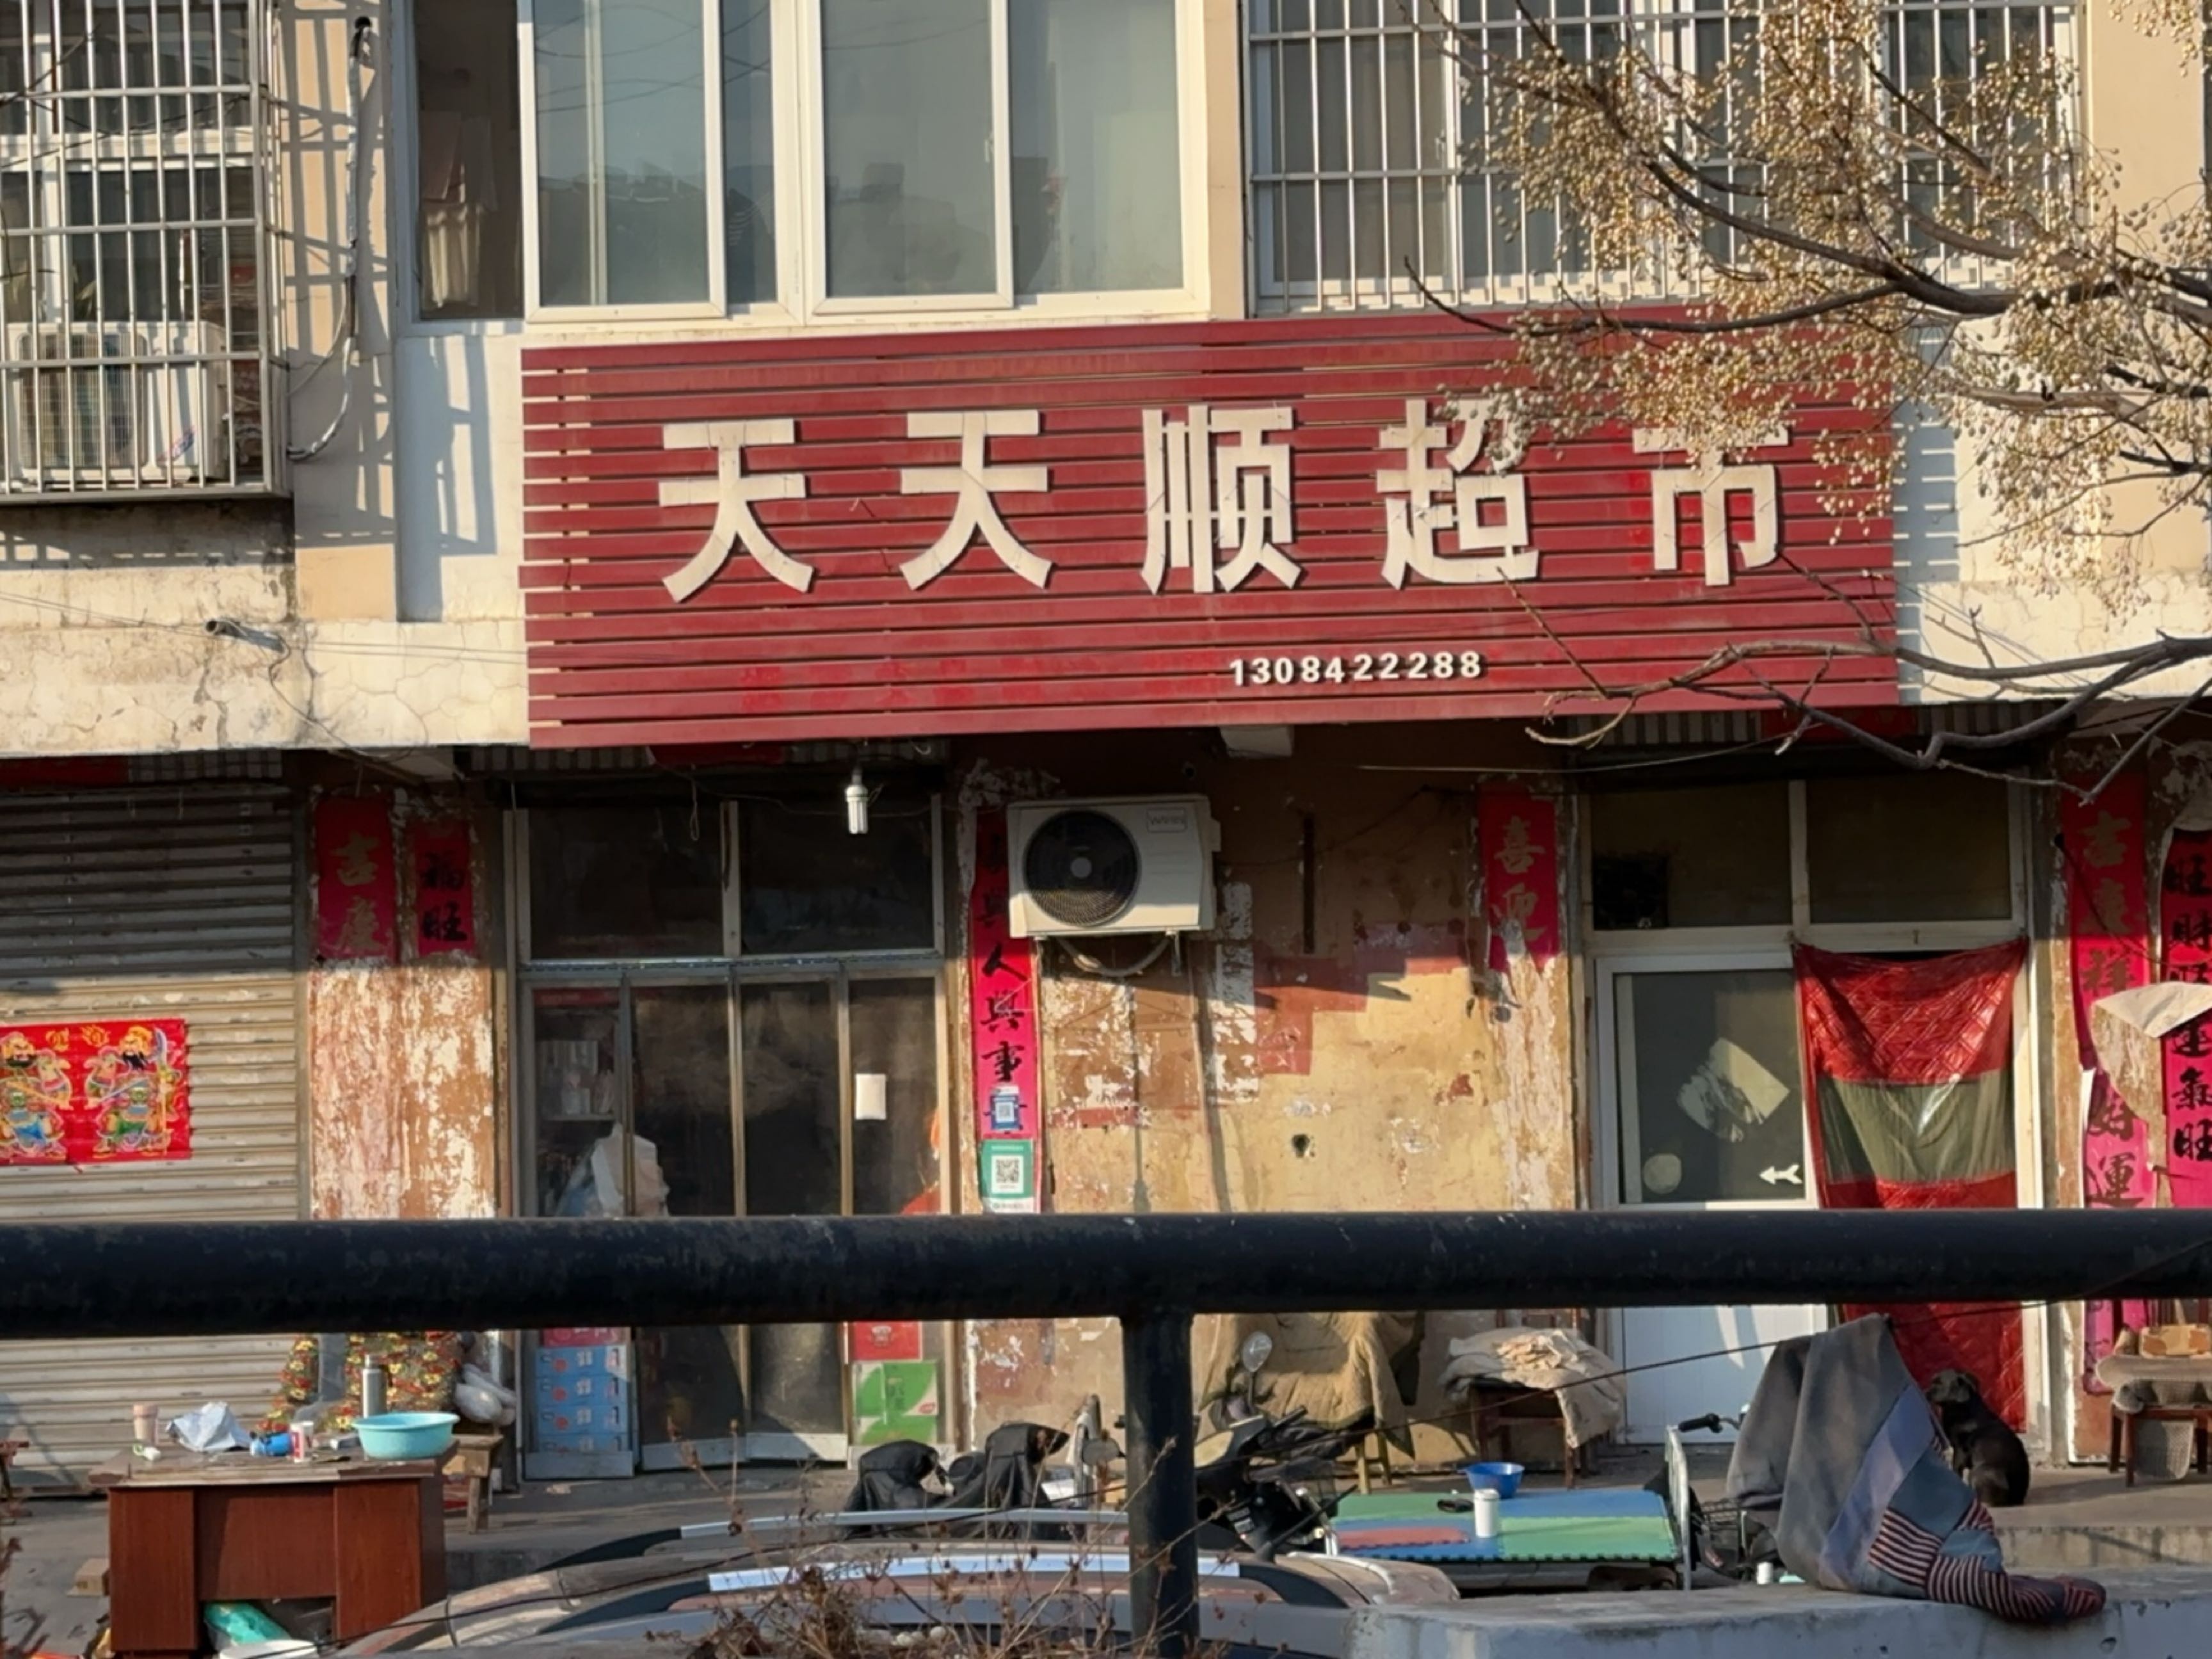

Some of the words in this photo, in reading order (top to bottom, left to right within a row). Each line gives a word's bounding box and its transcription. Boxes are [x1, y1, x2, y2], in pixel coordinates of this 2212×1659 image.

[659, 398, 1788, 603] 天天顺超市
[1230, 650, 1480, 686] 1308422288
